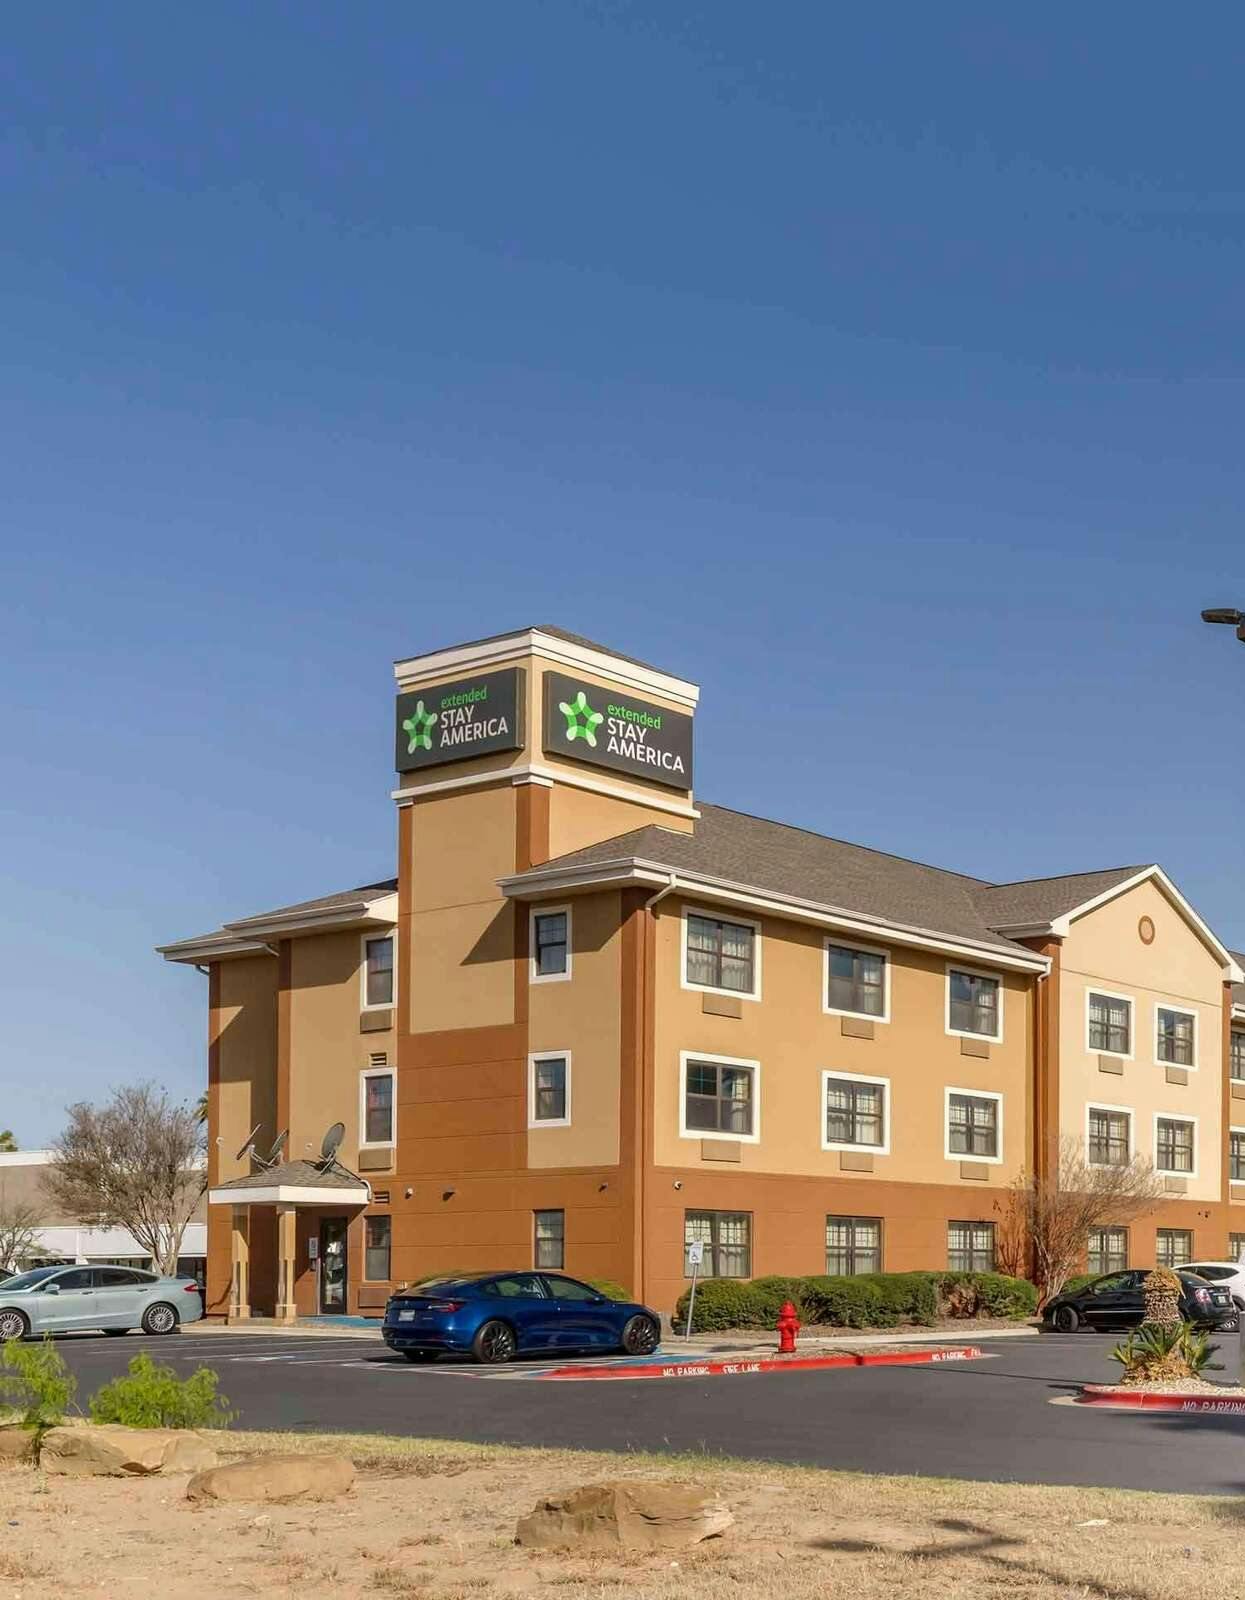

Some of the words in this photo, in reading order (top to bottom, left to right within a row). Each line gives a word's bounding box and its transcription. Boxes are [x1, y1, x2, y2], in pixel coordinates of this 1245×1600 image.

[440, 685, 487, 709] extended
[440, 705, 475, 729] STAY
[607, 703, 661, 730] extended
[440, 716, 508, 748] AMERICA
[607, 717, 647, 744] STAY
[607, 736, 685, 774] AMERICA
[662, 1367, 675, 1377] NO
[677, 1366, 710, 1376] PARKING
[722, 1364, 739, 1374] FIRE
[742, 1363, 761, 1373] LANE
[1181, 1401, 1197, 1412] NO
